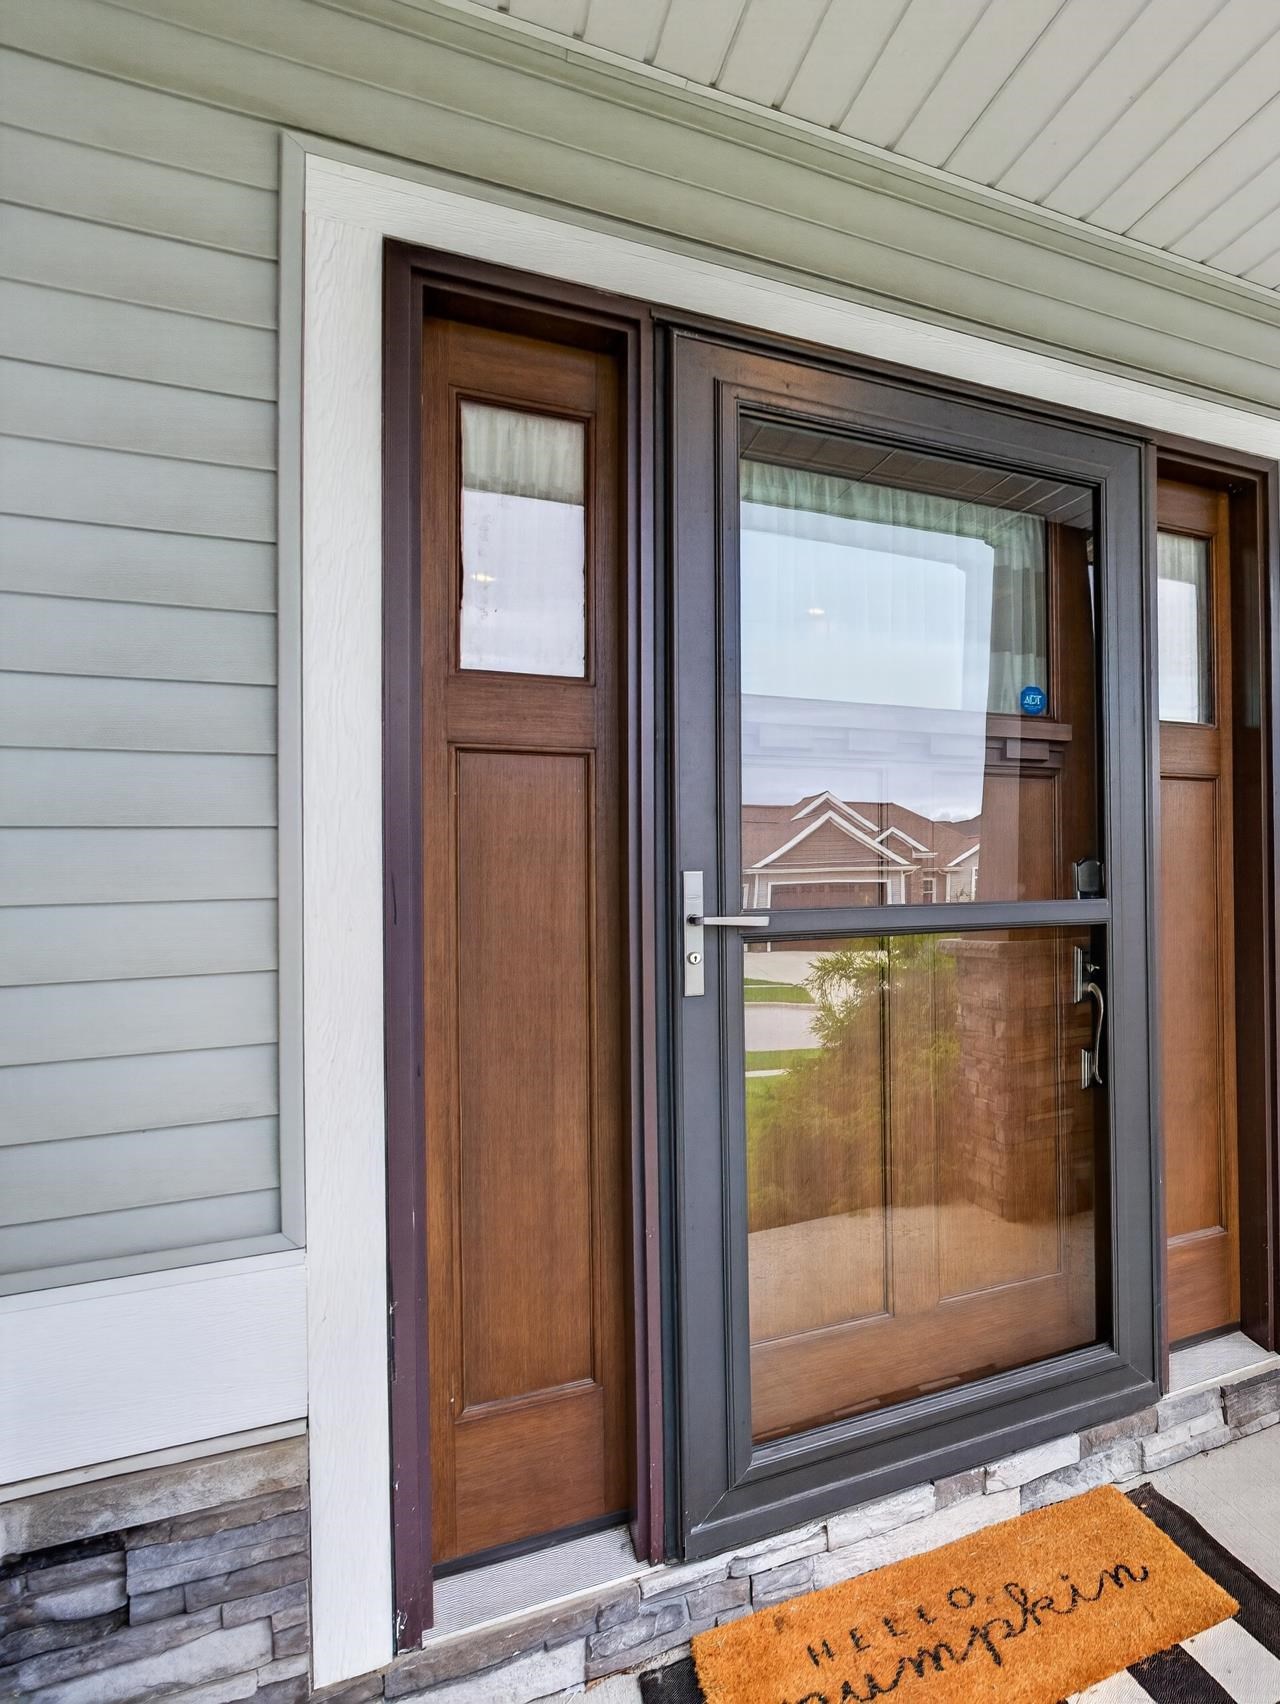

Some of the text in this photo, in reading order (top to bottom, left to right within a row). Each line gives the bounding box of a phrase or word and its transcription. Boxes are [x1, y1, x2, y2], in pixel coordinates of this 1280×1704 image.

[1023, 694, 1042, 705] ADT
[781, 1564, 1148, 1704] umpkin
[806, 1586, 976, 1667] HELLO
